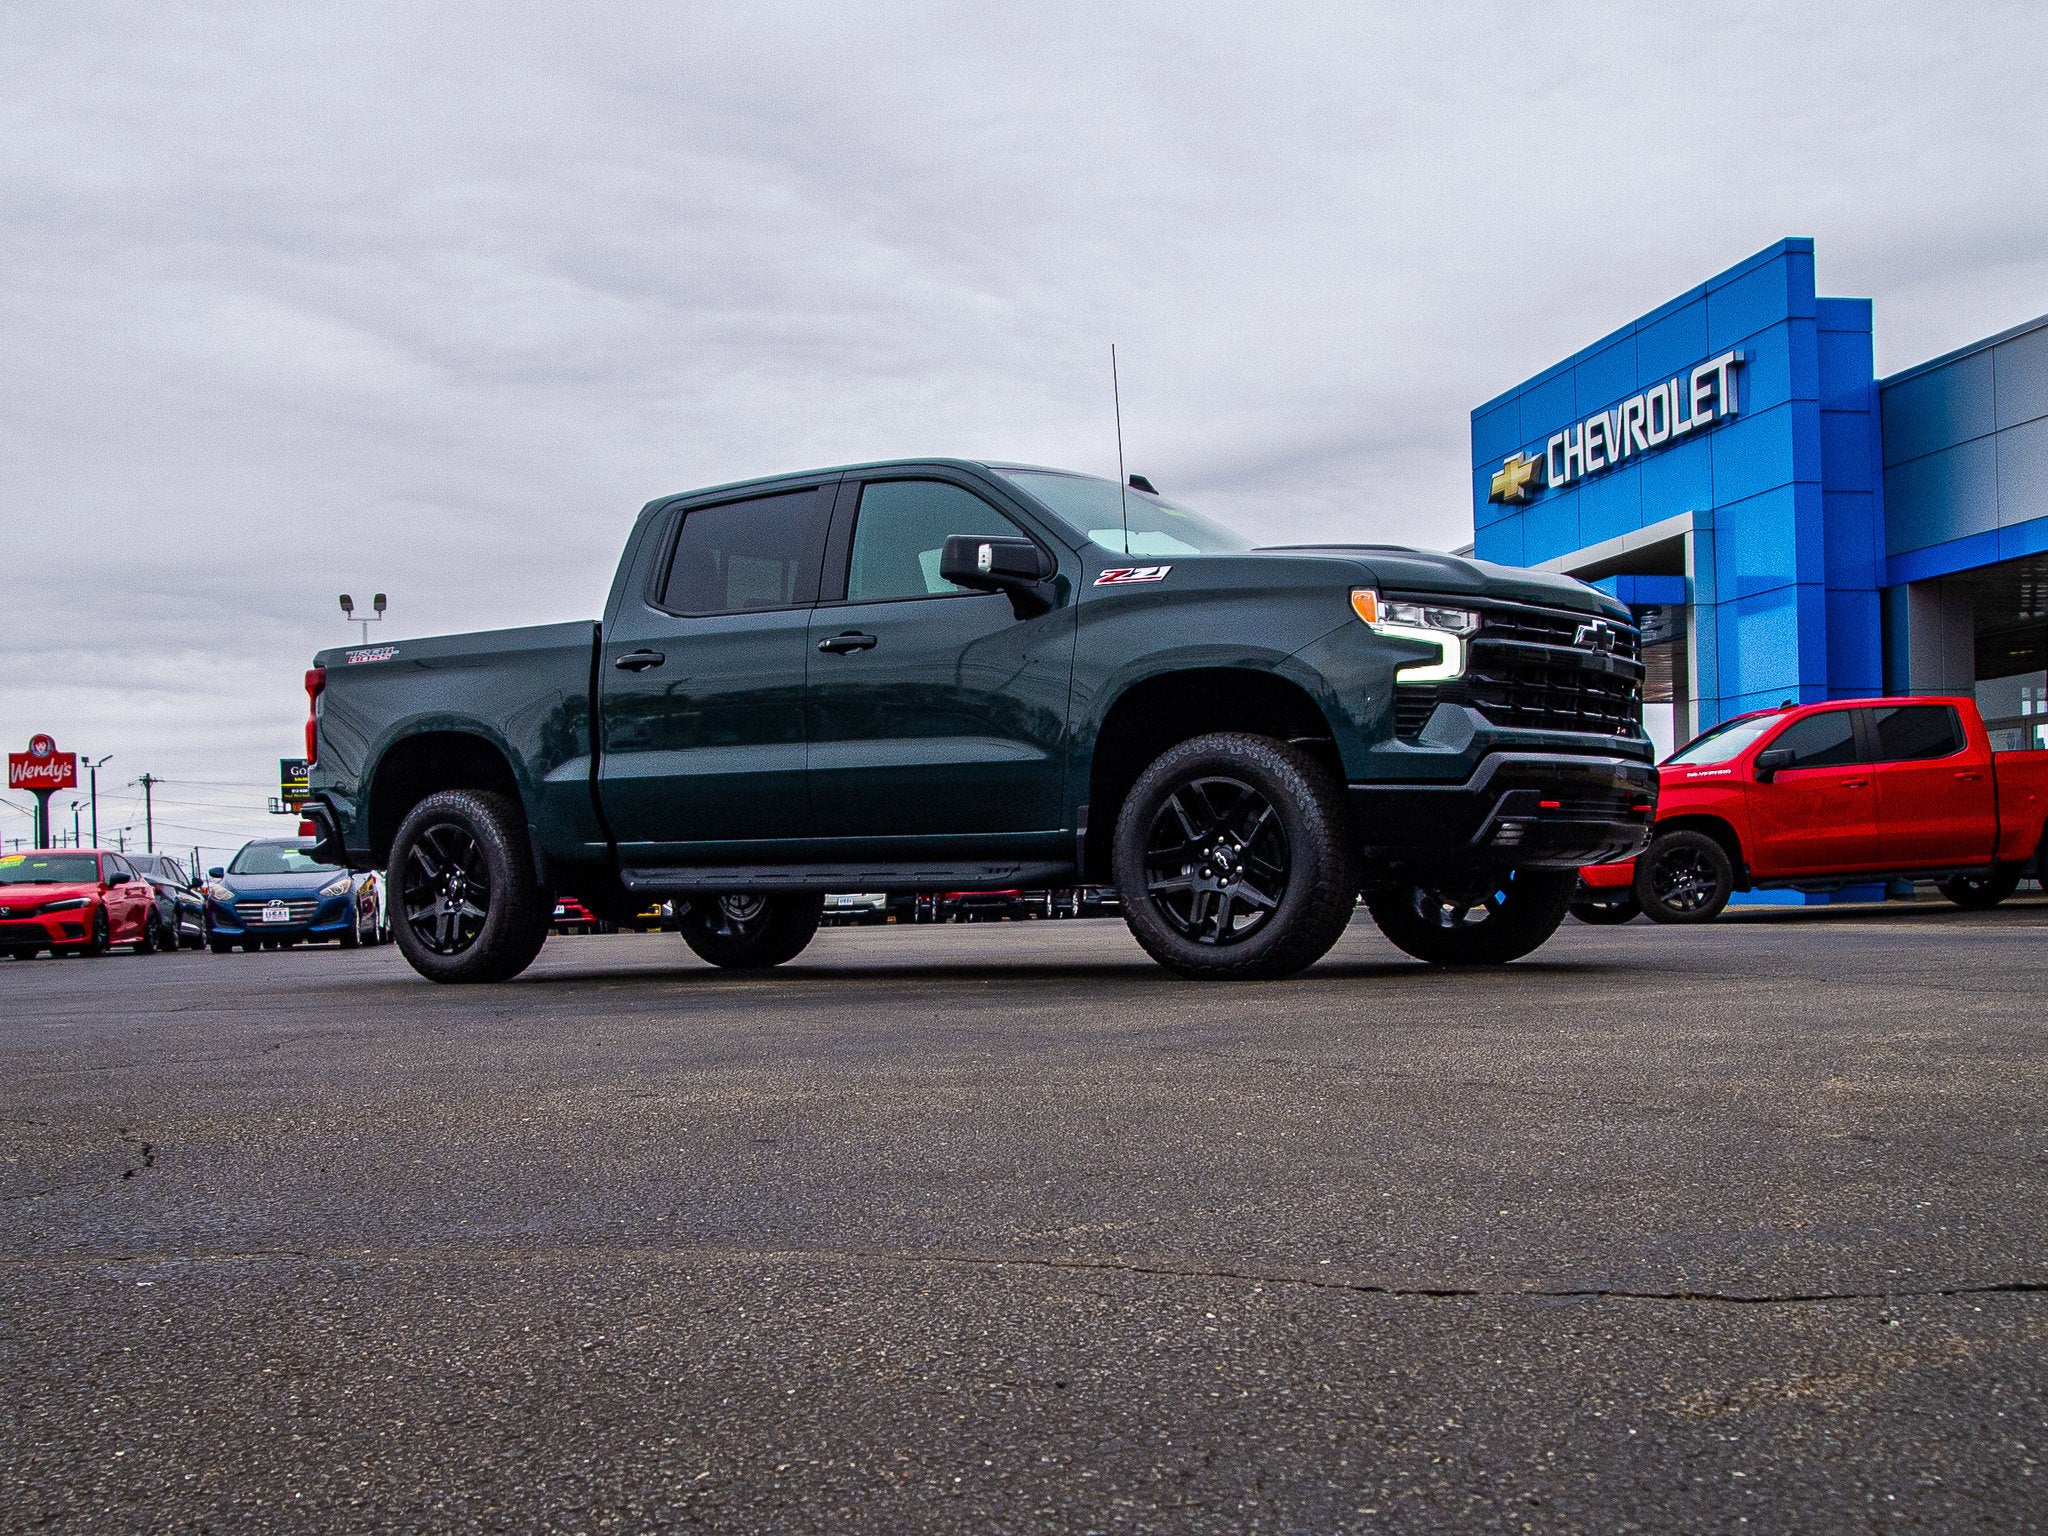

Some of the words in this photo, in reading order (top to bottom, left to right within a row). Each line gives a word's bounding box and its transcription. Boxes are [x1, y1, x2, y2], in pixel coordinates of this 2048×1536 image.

[1547, 350, 1740, 489] CHEVROLET
[1093, 565, 1173, 587] Z71
[10, 758, 73, 784] Wendy's
